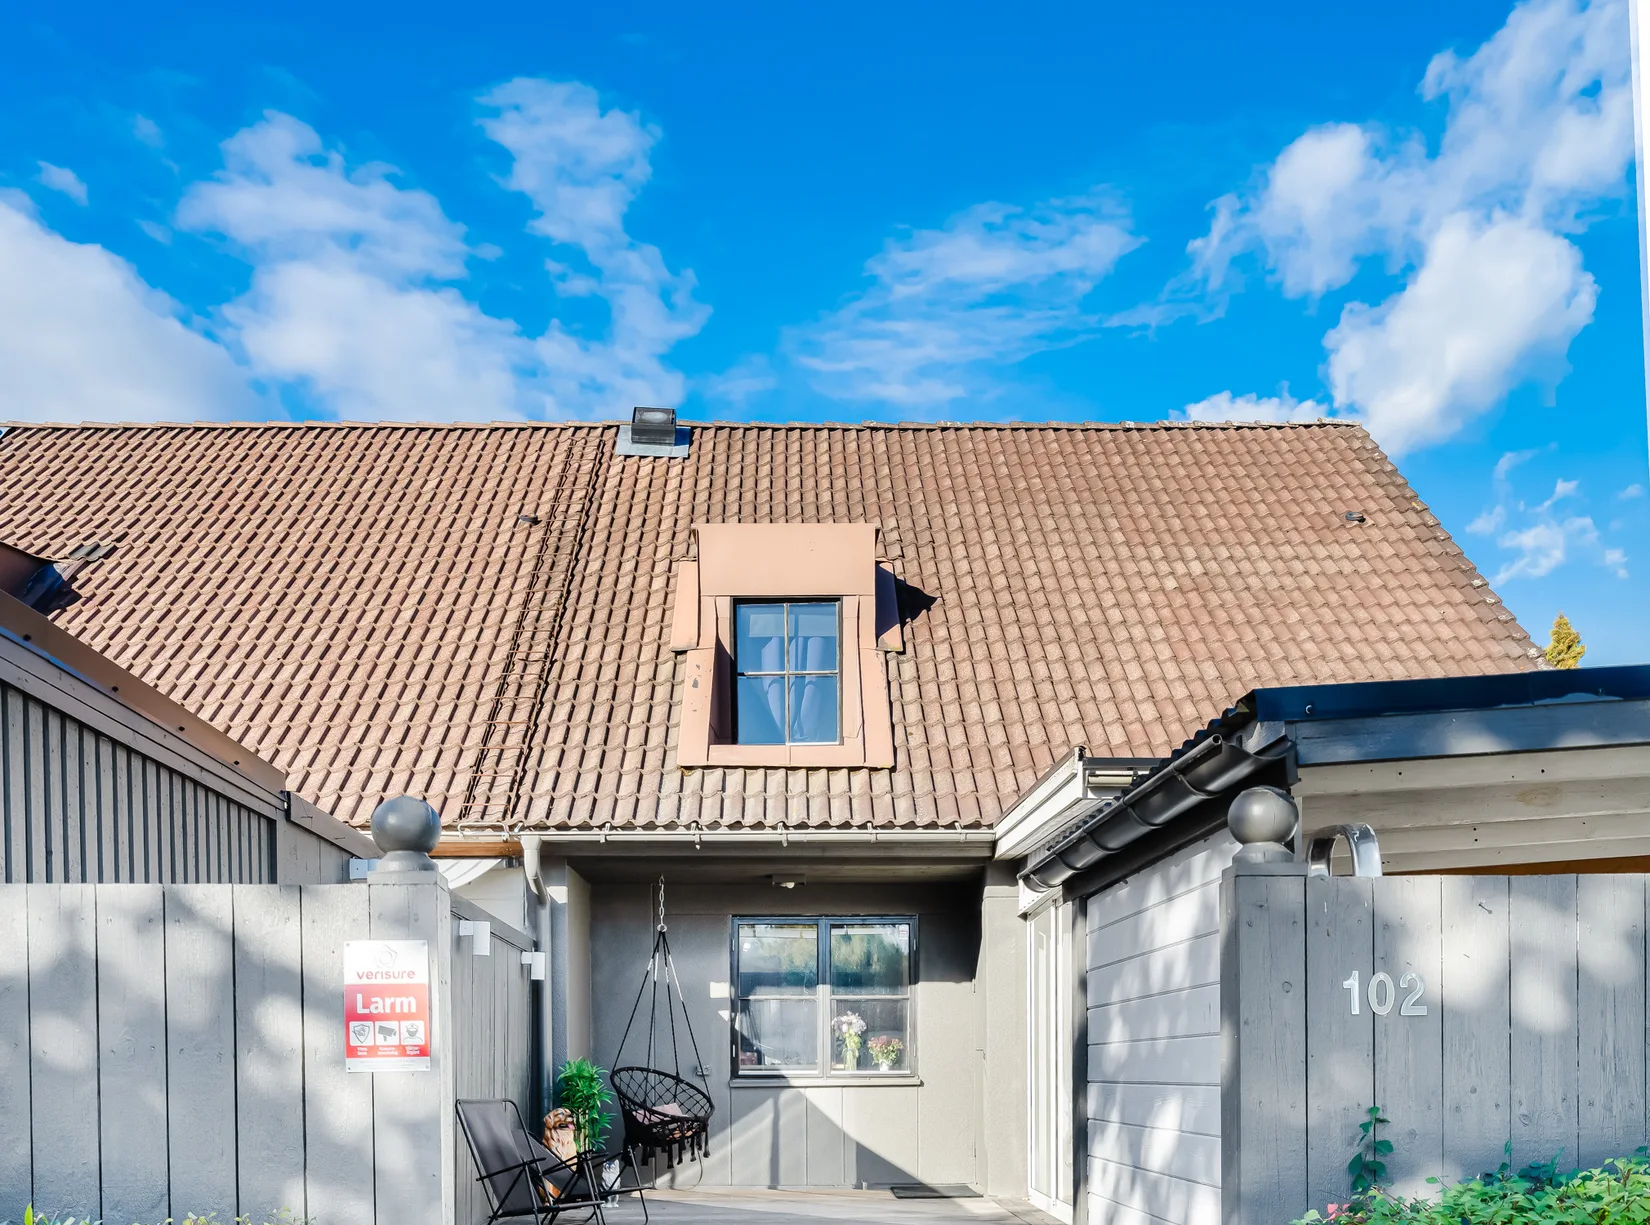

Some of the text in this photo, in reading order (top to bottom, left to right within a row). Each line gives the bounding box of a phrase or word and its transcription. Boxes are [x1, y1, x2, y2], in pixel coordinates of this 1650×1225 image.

[356, 970, 416, 980] verisure
[356, 993, 417, 1014] Larm
[1342, 970, 1428, 1016] 102
